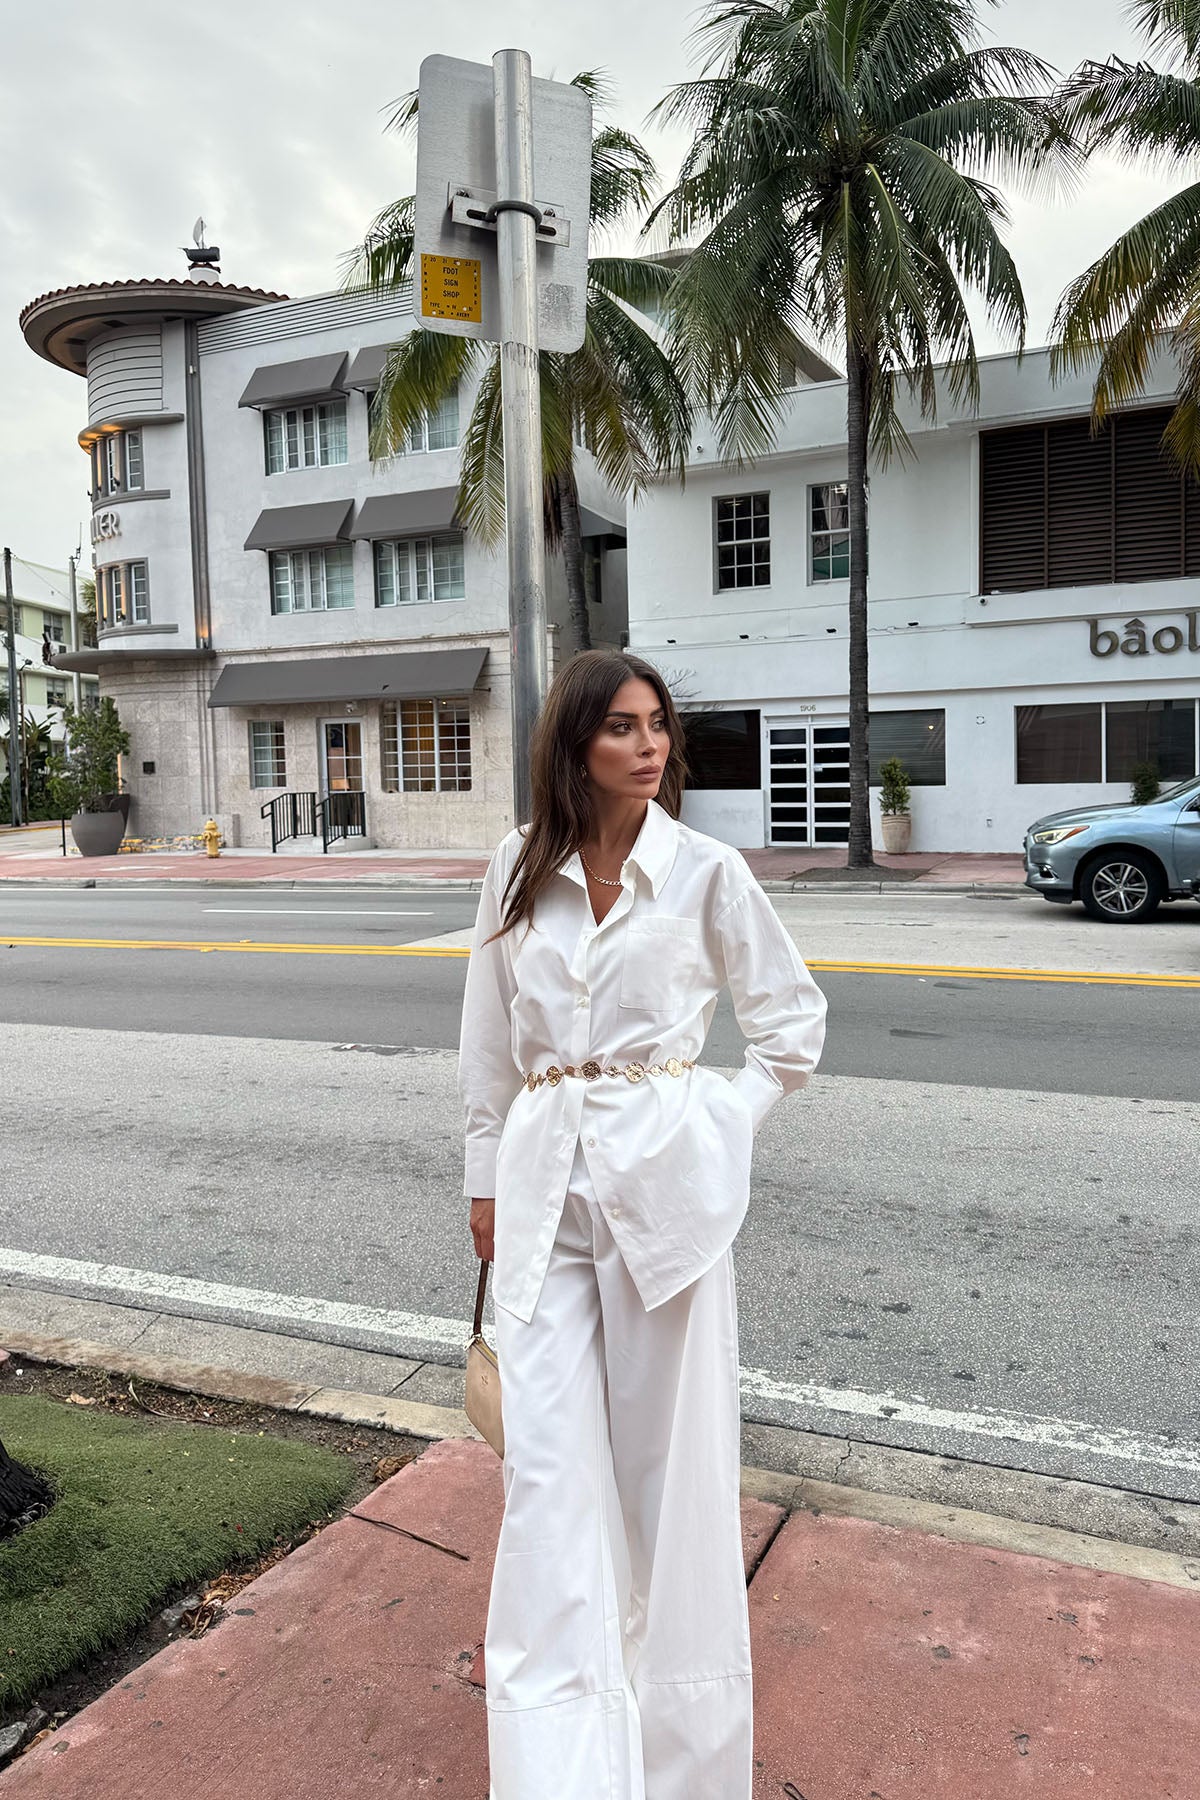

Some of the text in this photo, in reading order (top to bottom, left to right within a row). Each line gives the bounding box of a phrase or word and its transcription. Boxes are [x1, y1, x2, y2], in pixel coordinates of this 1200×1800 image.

[443, 267, 458, 275] FDOT
[444, 278, 459, 287] SIGN
[443, 290, 460, 298] SHOP
[1086, 611, 1200, 657] bâol
[800, 704, 817, 712] 1906
